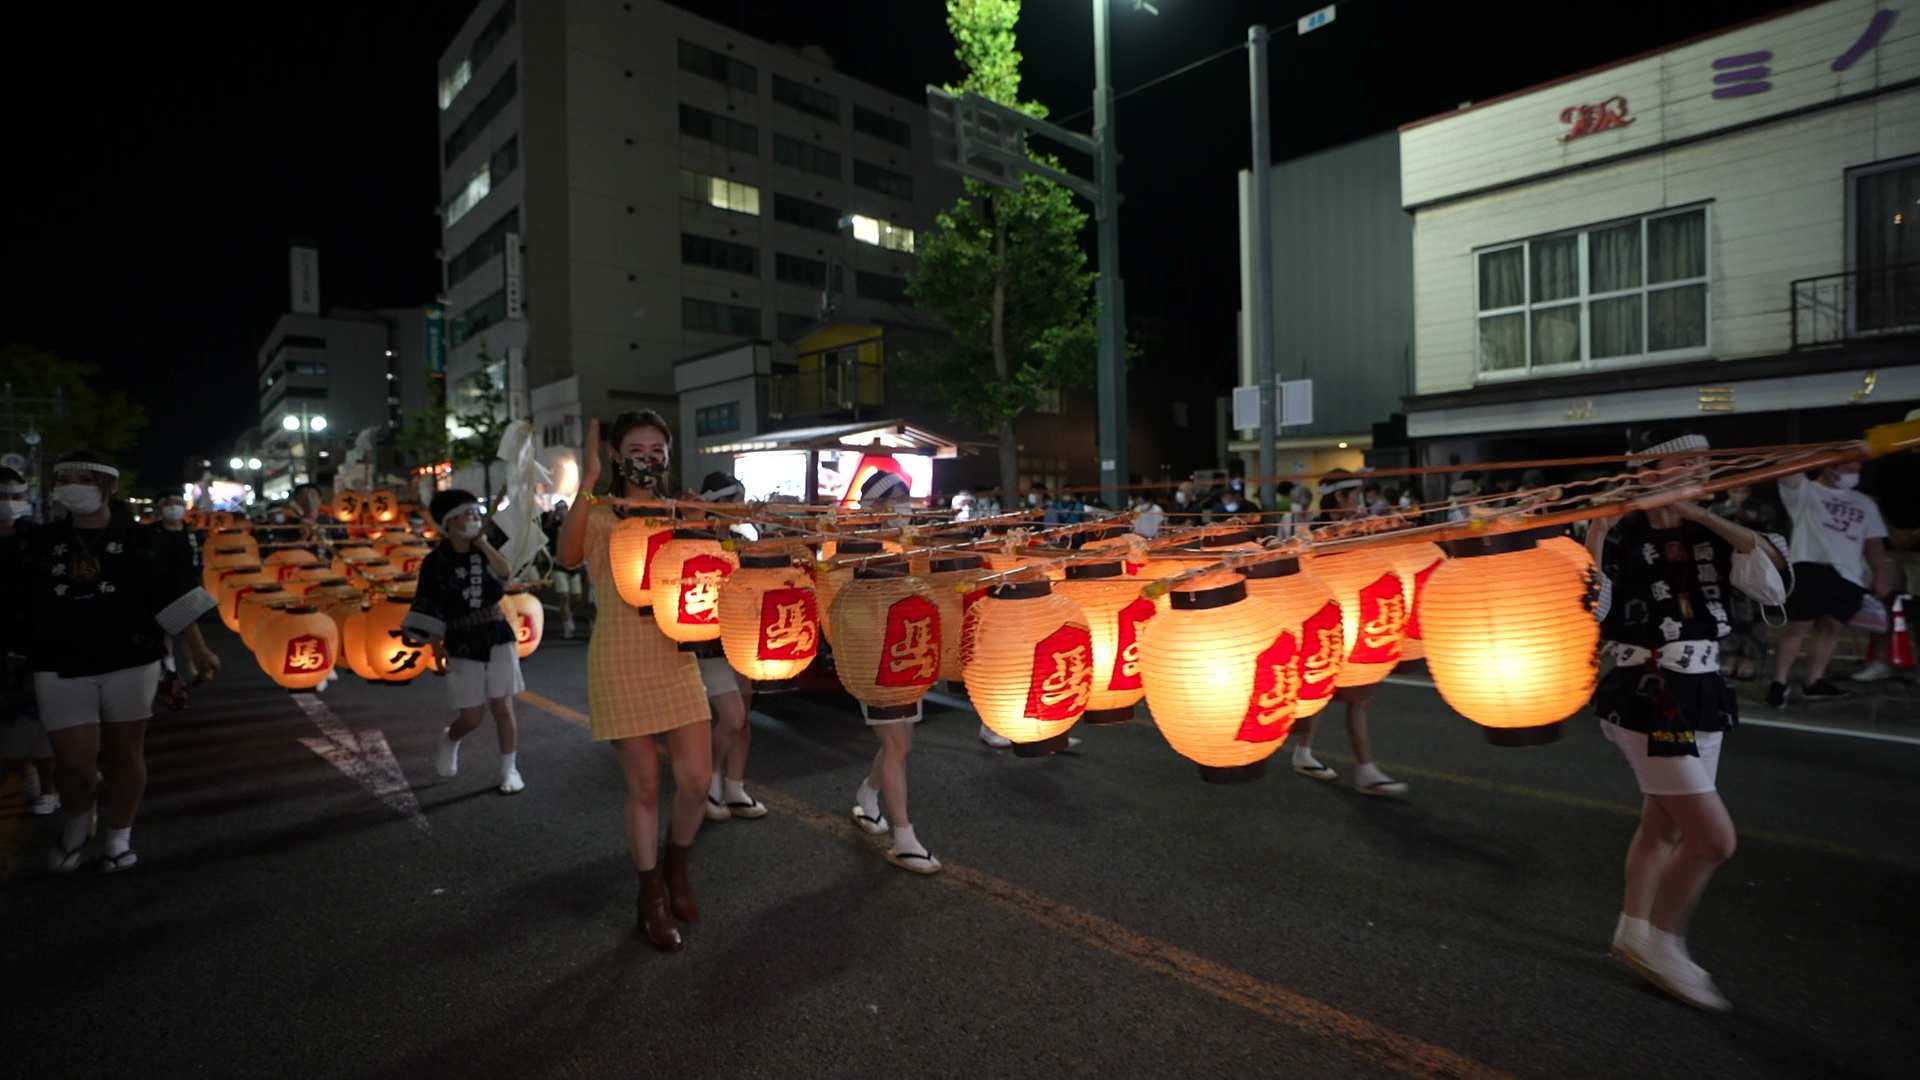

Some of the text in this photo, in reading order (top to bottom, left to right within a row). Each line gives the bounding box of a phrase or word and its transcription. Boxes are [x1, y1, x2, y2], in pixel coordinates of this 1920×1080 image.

[765, 599, 817, 655] 馬
[889, 616, 938, 681] 馬
[1365, 594, 1408, 653] 馬
[289, 639, 324, 670] 馬
[1041, 645, 1092, 711] 馬
[1304, 624, 1343, 684] 馬
[1257, 655, 1300, 726] 馬
